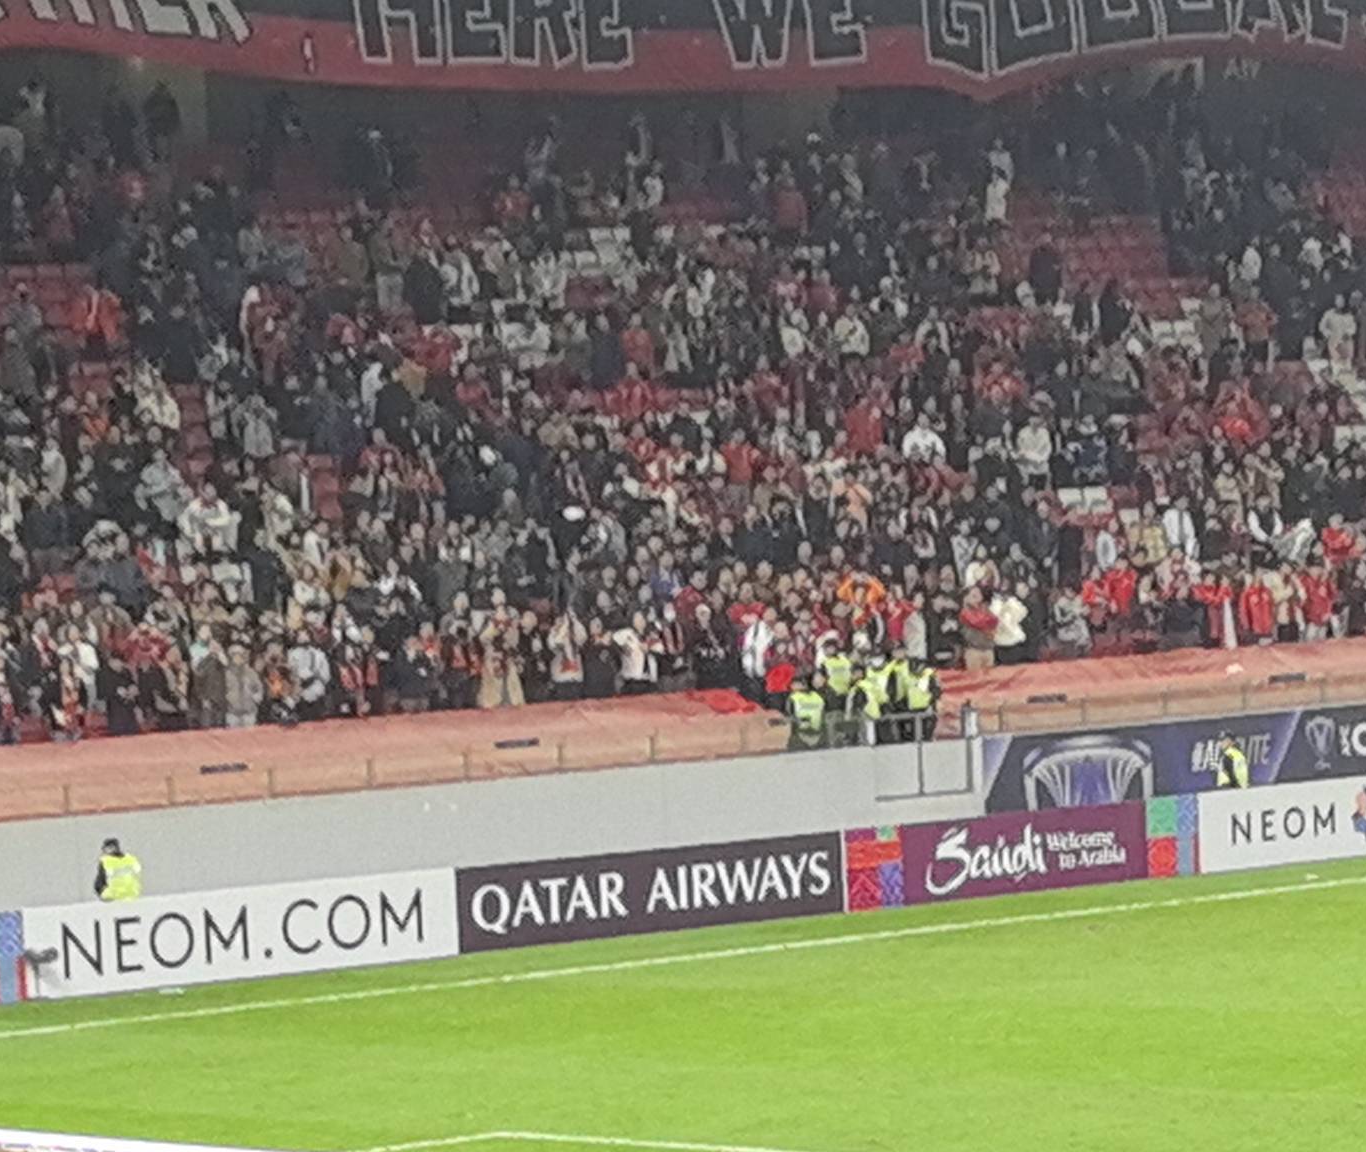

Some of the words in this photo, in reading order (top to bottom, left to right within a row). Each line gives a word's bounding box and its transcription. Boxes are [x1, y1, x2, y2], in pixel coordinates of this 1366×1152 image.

[1230, 802, 1337, 847] NEOM
[60, 887, 427, 981] NEOM.COM
[471, 871, 630, 935] QATAR
[646, 850, 832, 914] AIRWAYS
